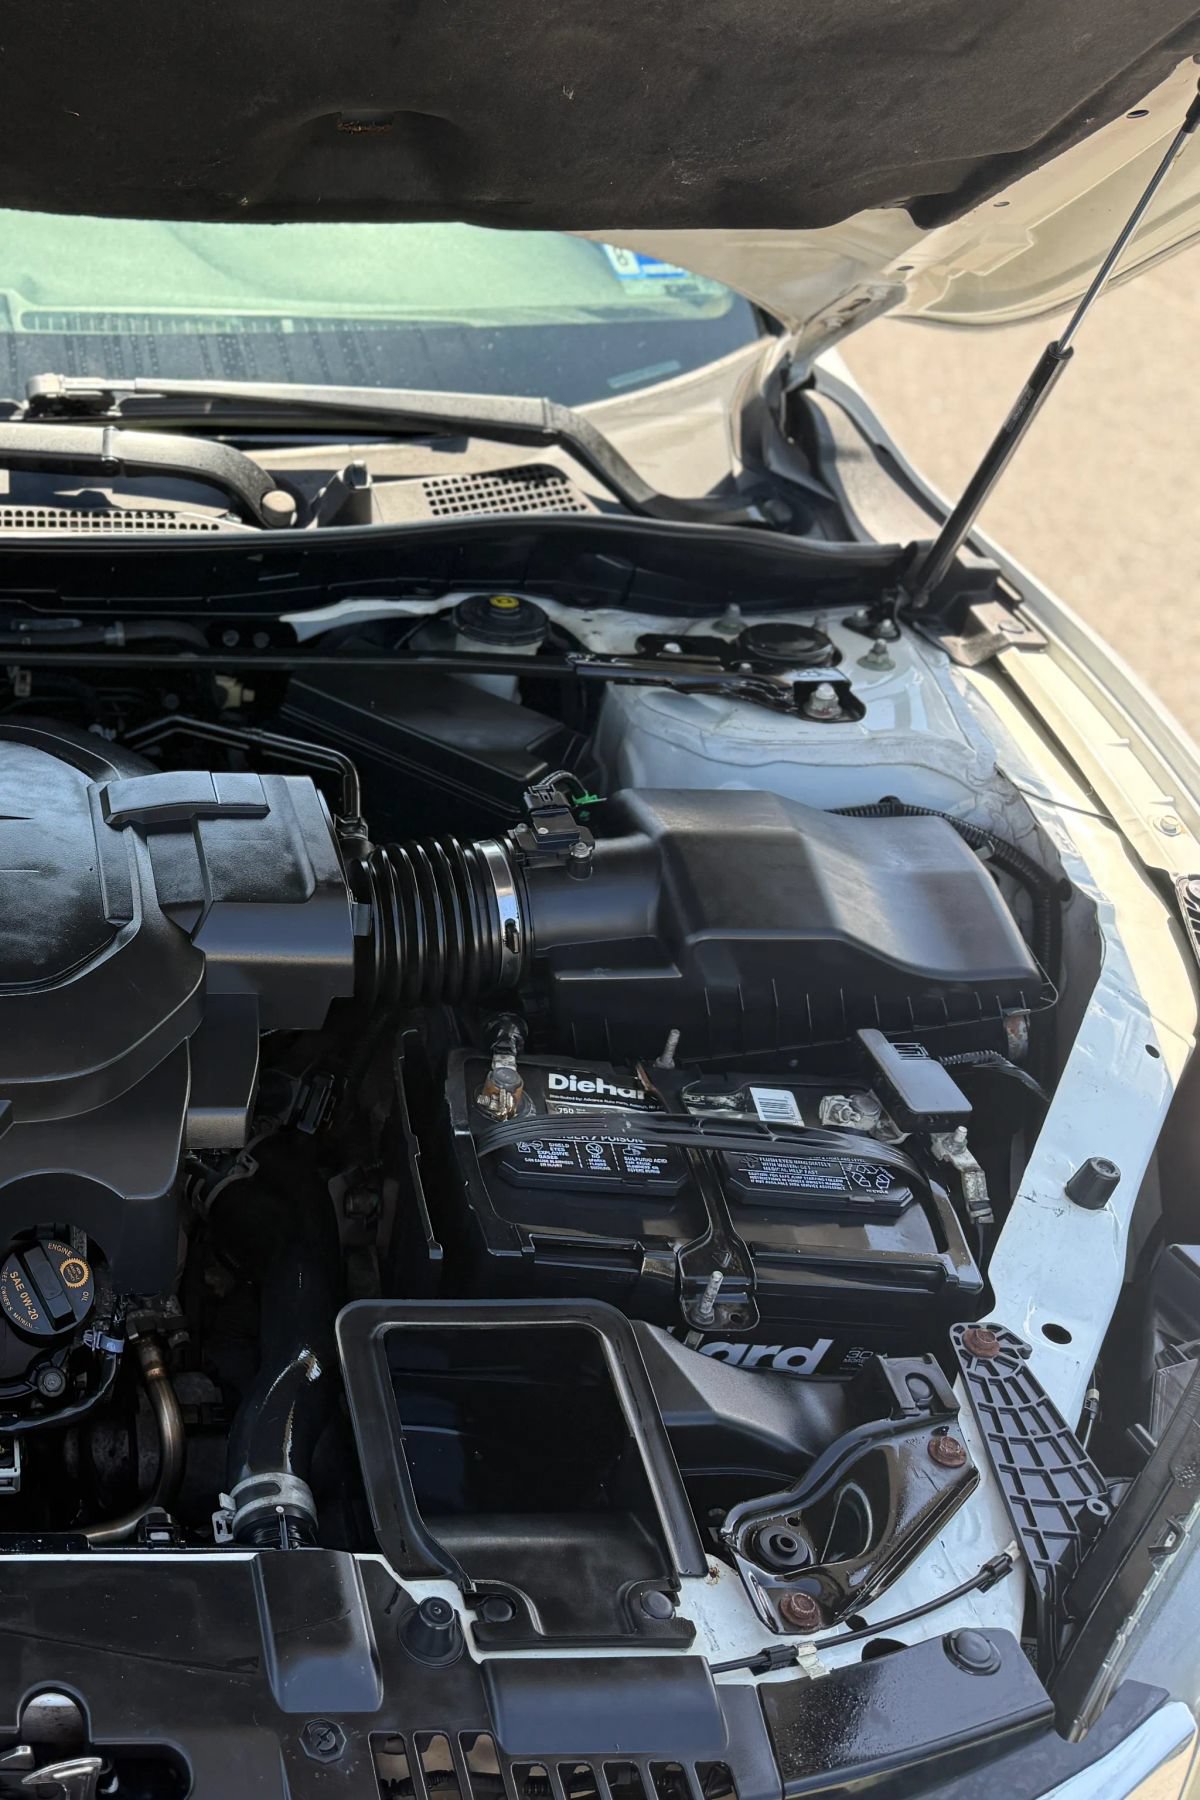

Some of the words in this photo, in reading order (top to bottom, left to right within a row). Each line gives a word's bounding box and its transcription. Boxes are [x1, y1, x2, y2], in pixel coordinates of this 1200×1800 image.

[548, 1073, 645, 1100] Diehar
[48, 1242, 73, 1257] ENGINE
[10, 1271, 25, 1291] SAE
[20, 1292, 38, 1320] 0W-20
[699, 1338, 834, 1374] ard
